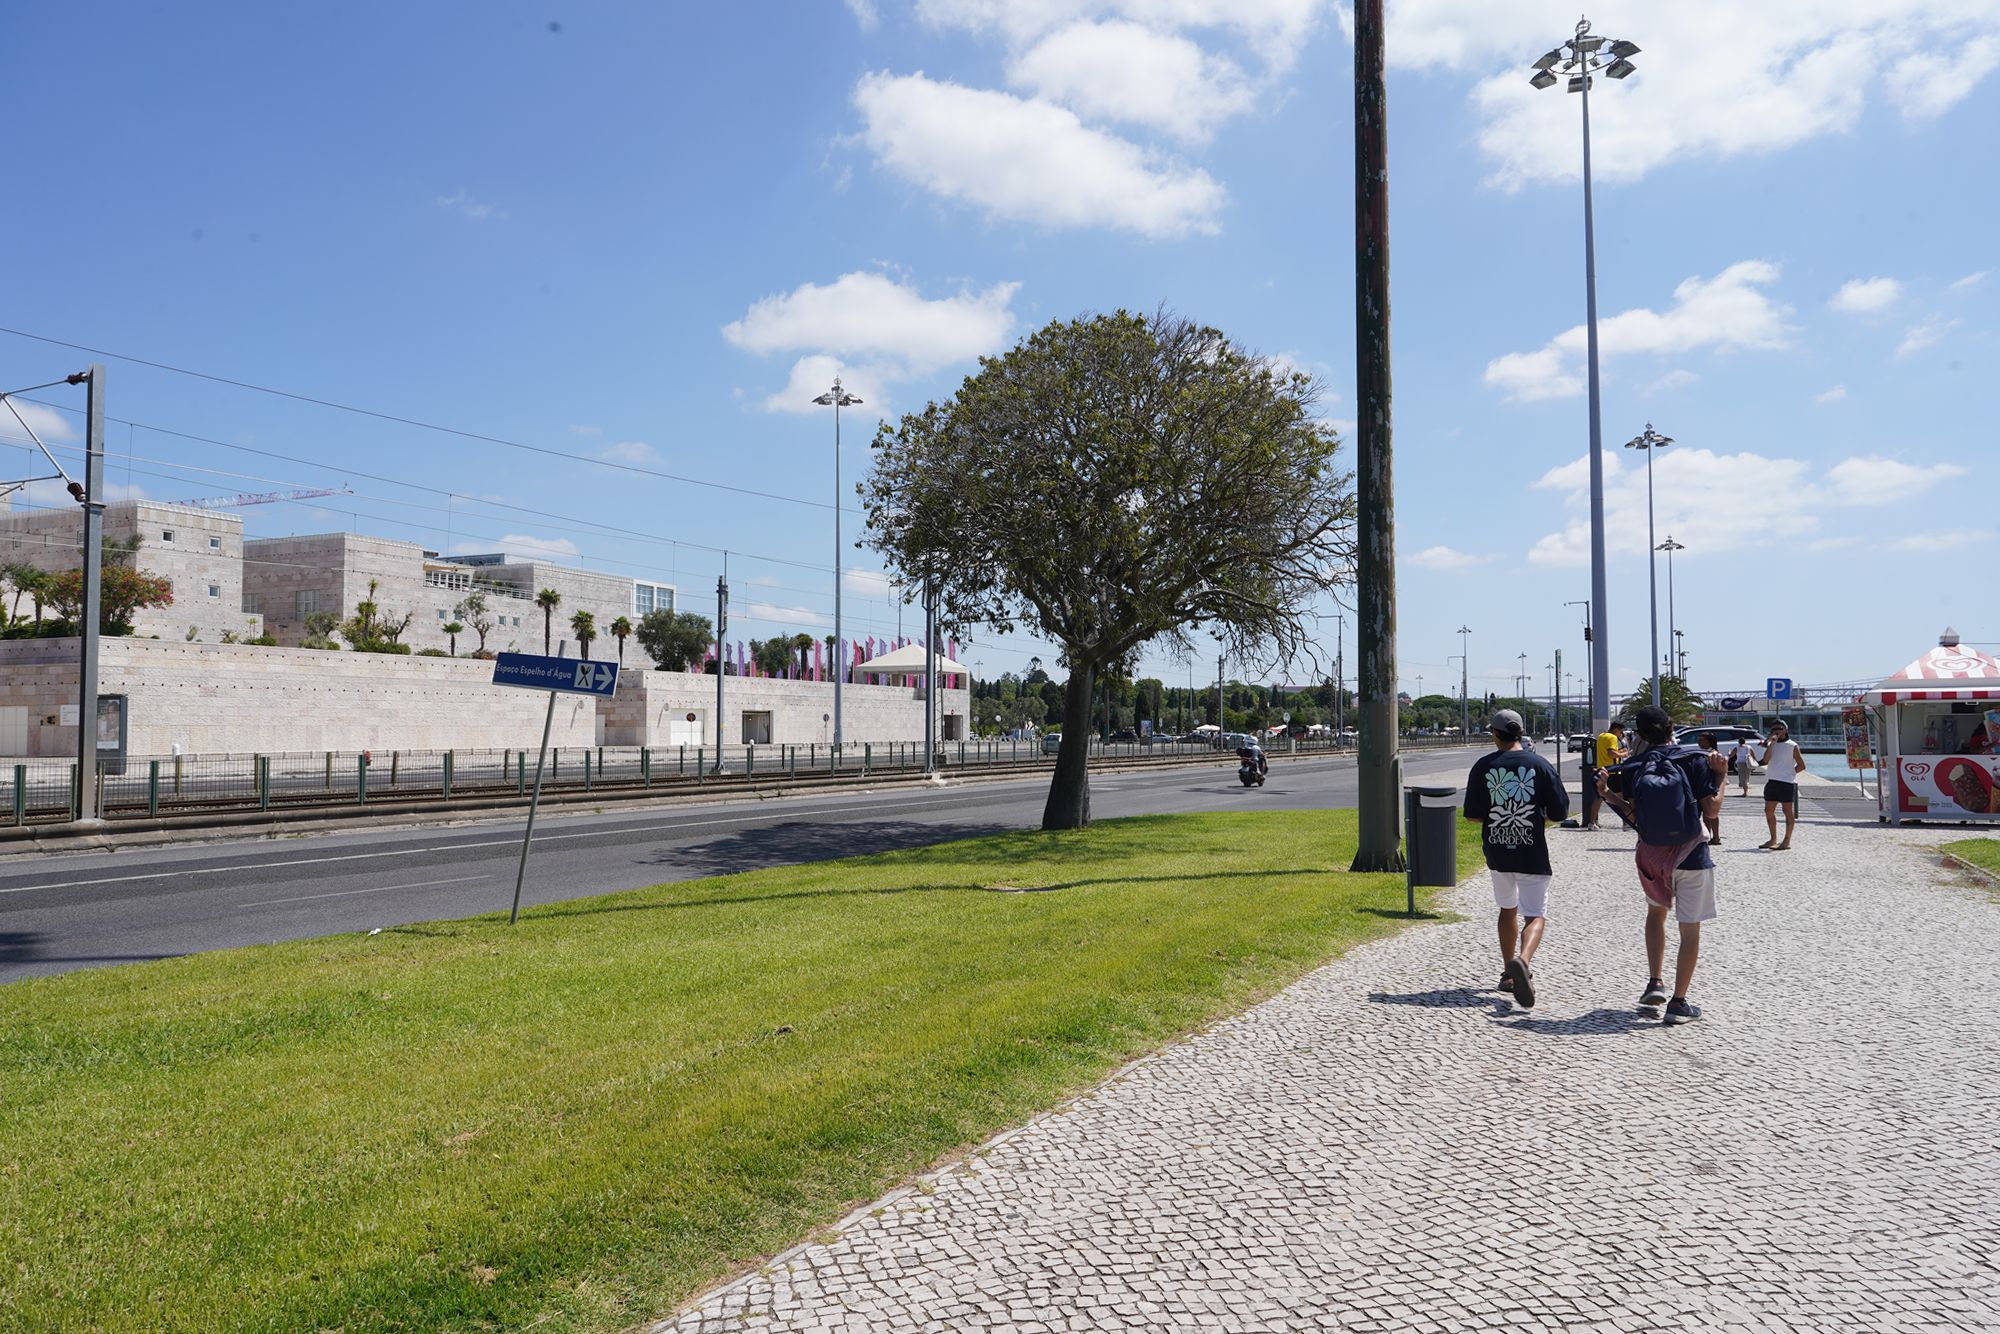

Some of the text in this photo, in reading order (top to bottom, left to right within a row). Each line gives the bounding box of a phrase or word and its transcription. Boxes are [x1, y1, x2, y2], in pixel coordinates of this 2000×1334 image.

[496, 663, 519, 674] Espaço
[520, 665, 545, 676] Espelho
[1772, 680, 1785, 697] P
[1490, 827, 1532, 836] BOTANIC
[1488, 835, 1534, 845] GARDENS
